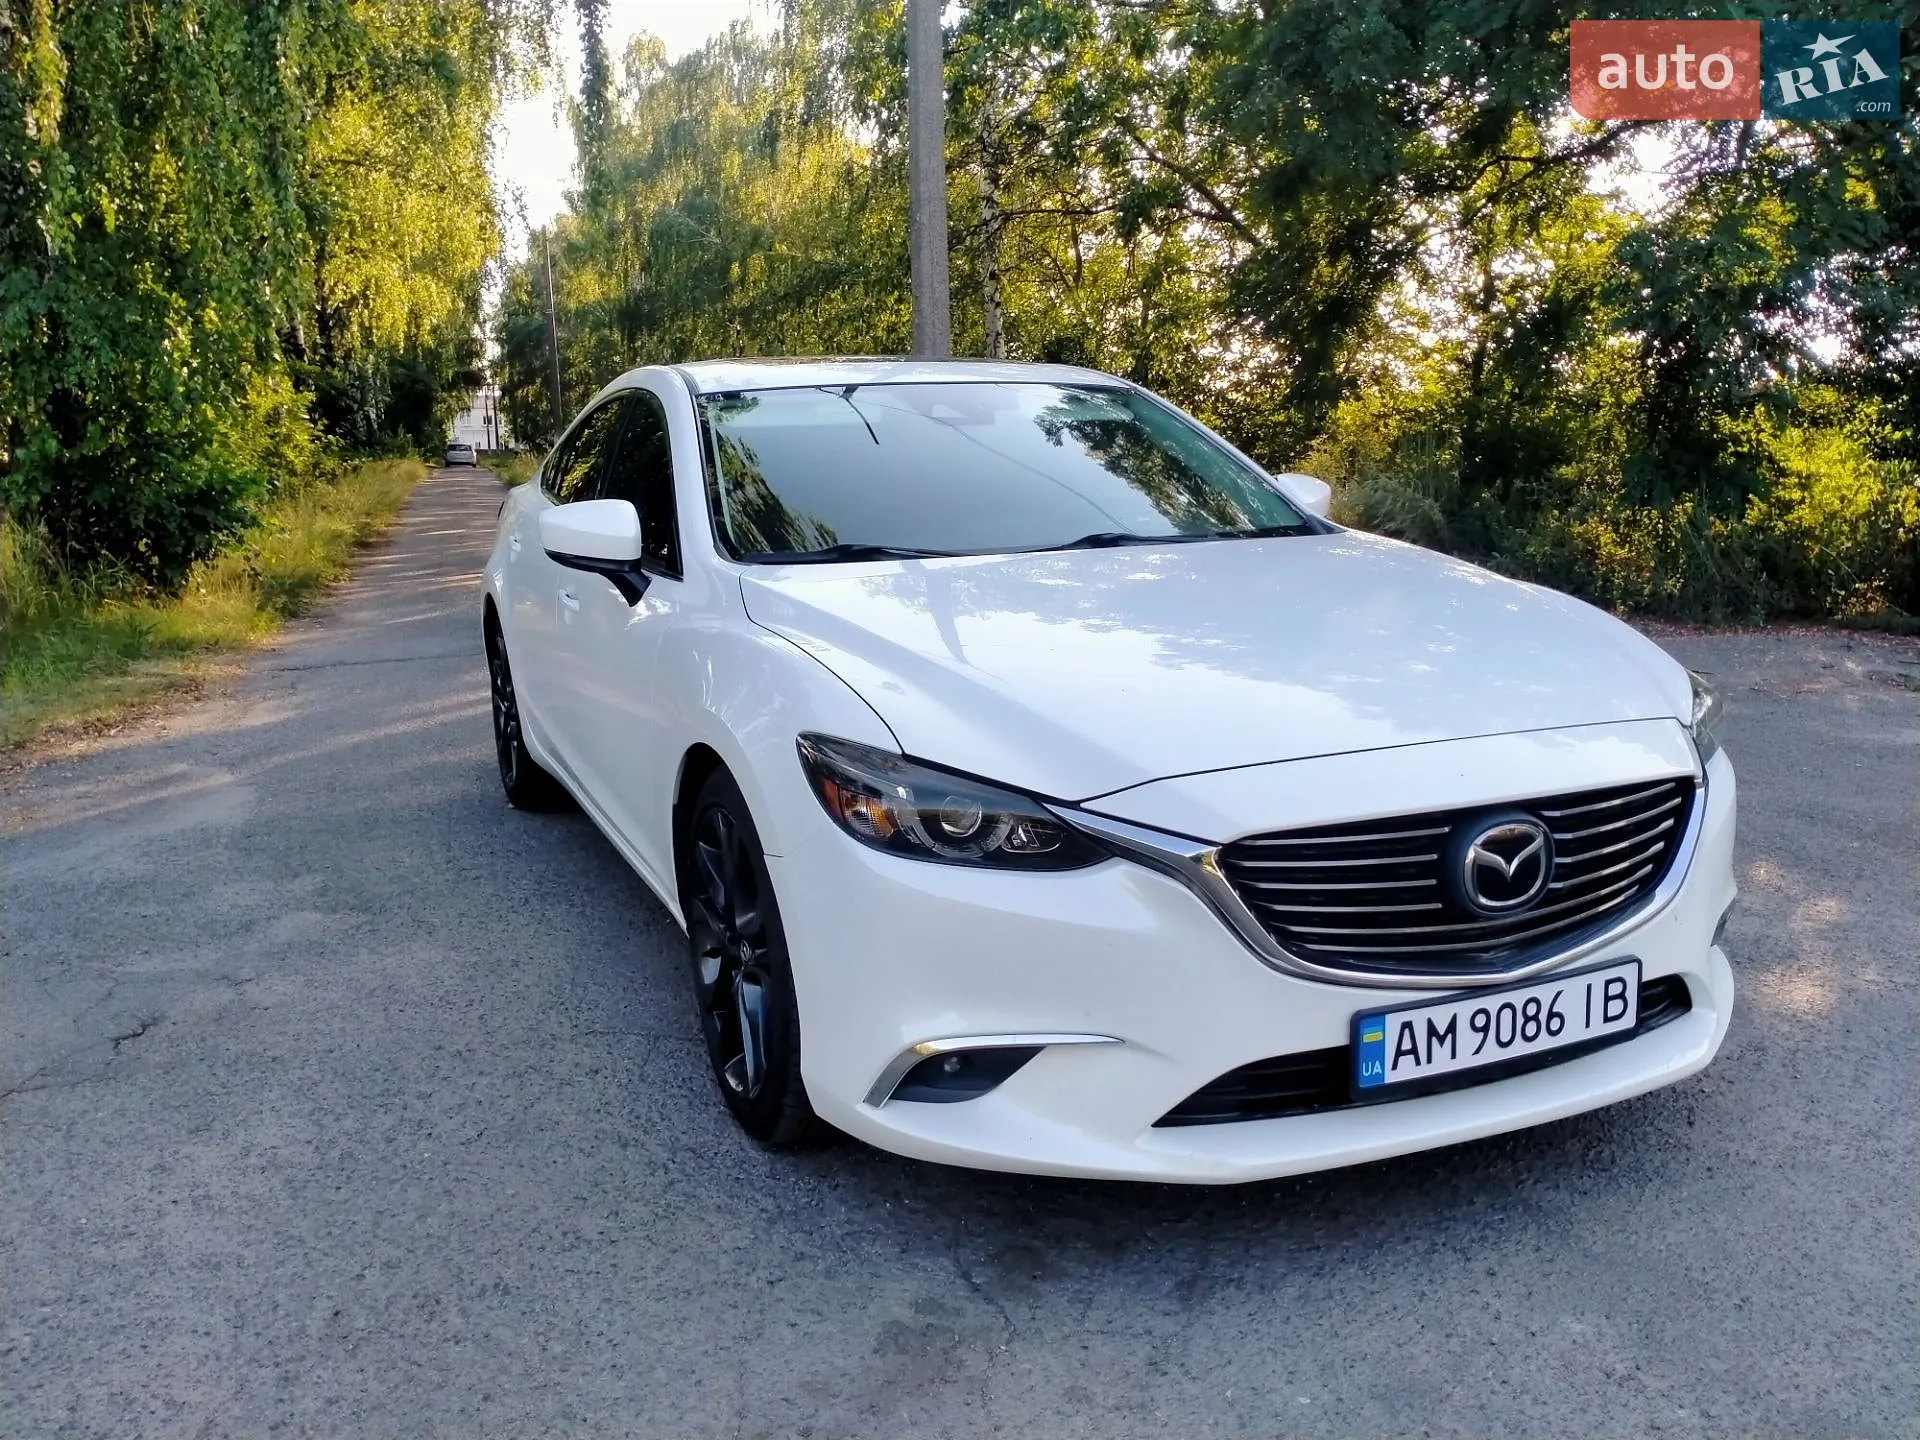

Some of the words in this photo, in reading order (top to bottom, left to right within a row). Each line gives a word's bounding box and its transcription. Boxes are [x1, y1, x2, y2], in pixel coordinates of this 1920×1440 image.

[1391, 1012, 1457, 1071] AM
[1469, 989, 1566, 1056] 9086
[1585, 976, 1629, 1029] IB
[1362, 1060, 1382, 1077] UA
